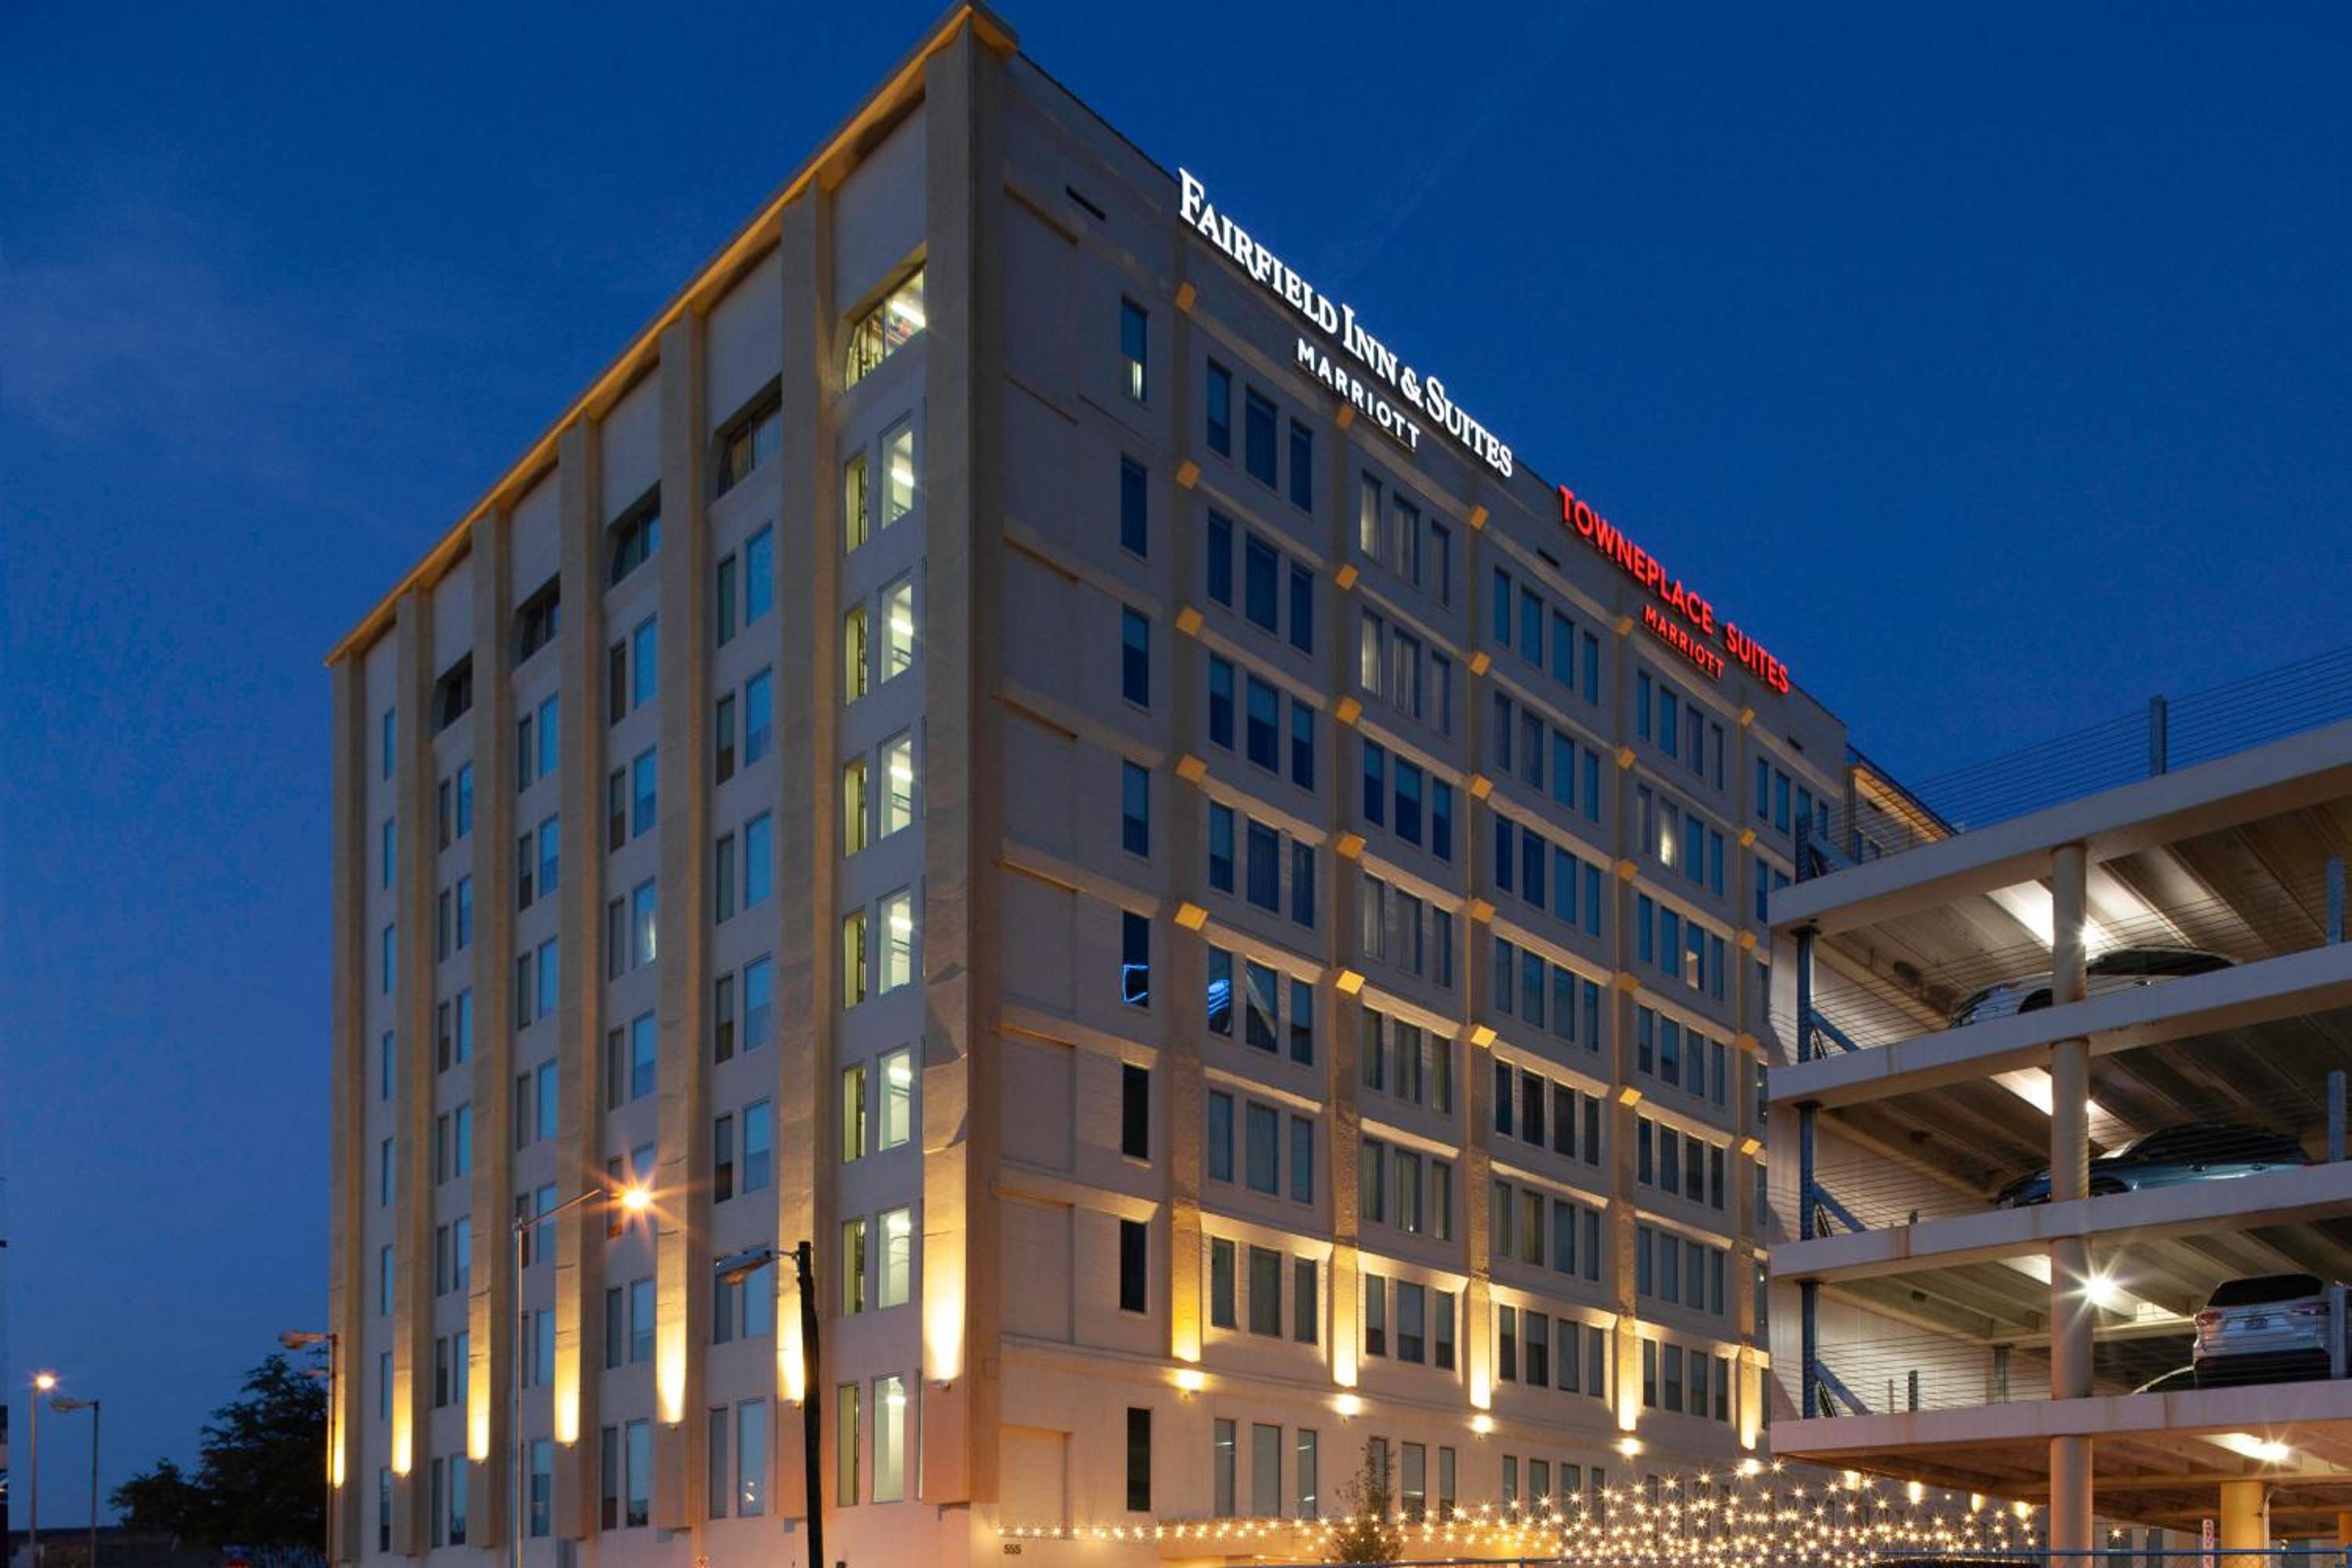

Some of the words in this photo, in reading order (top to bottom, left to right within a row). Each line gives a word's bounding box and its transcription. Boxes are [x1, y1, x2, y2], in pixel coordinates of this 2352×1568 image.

[1179, 168, 1338, 335] FAIRFIELD
[1341, 303, 1398, 386] INN
[1400, 367, 1424, 408] &
[1426, 376, 1512, 477] SUITES
[1298, 338, 1420, 448] MARRIOTT
[1558, 485, 1713, 636] TOWNEPLACE
[1726, 622, 1789, 694] SUITES
[1645, 604, 1725, 678] MARRIOTT
